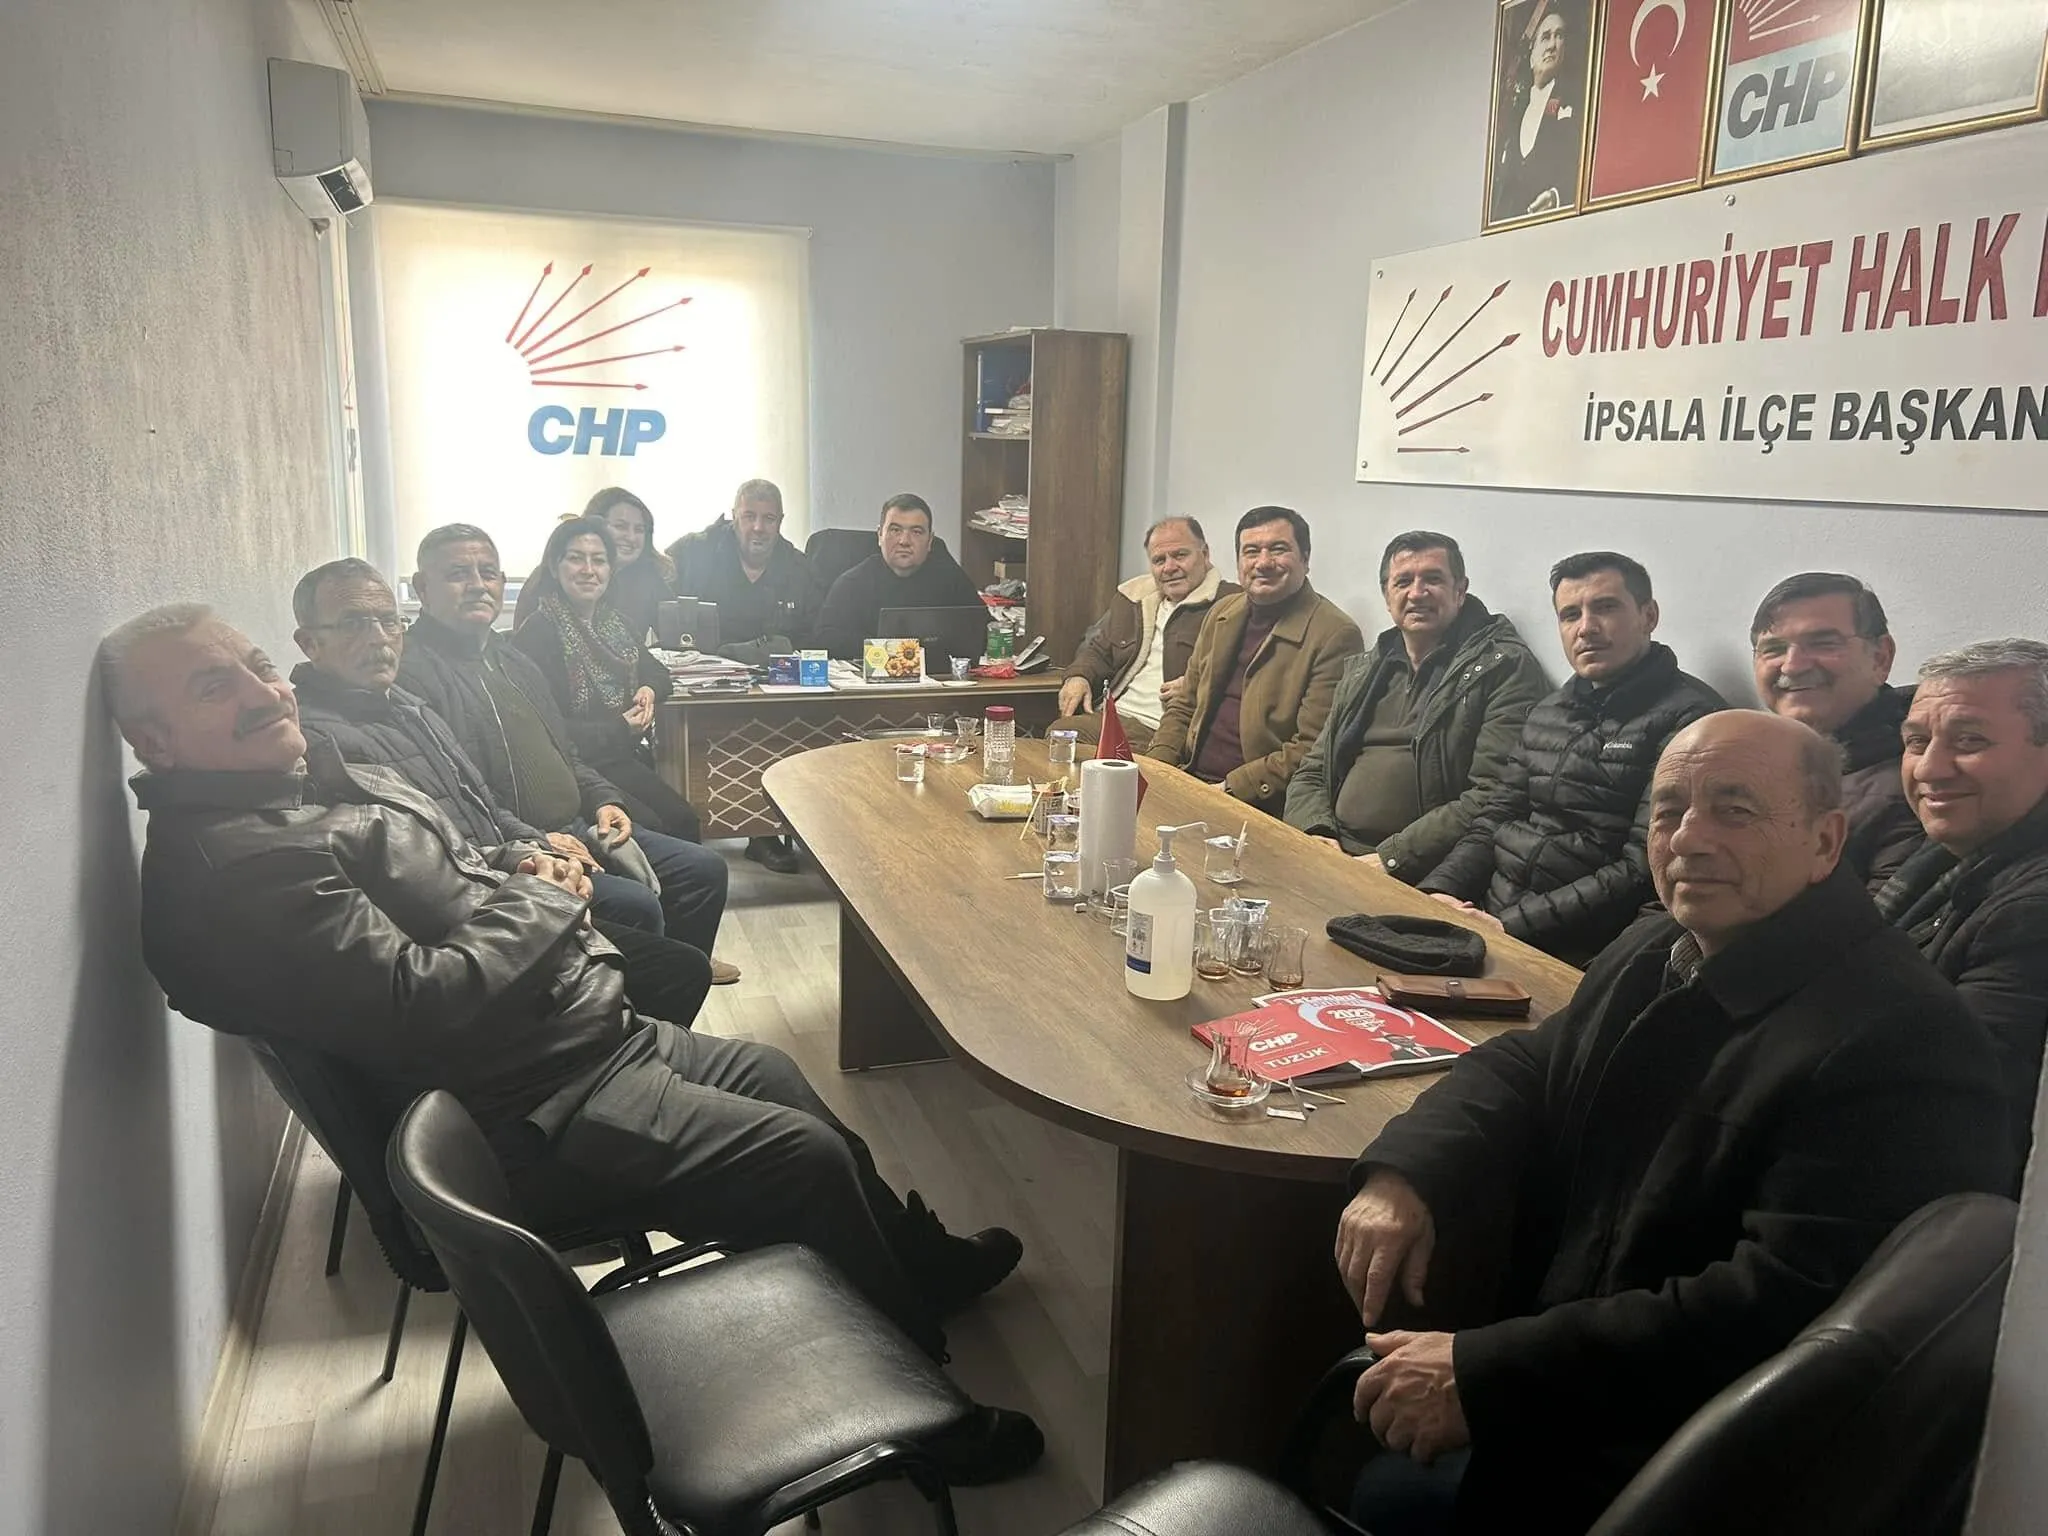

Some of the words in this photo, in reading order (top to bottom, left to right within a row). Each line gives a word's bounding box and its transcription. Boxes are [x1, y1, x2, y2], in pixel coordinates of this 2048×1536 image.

[1727, 51, 1851, 139] CHP
[1542, 233, 1833, 358] CUMHURİYET
[1841, 213, 2021, 333] HALK
[527, 405, 666, 456] CHP
[1584, 391, 1704, 442] İPSALA
[1719, 385, 1816, 454] İLÇE
[1249, 1032, 1299, 1052] CHP
